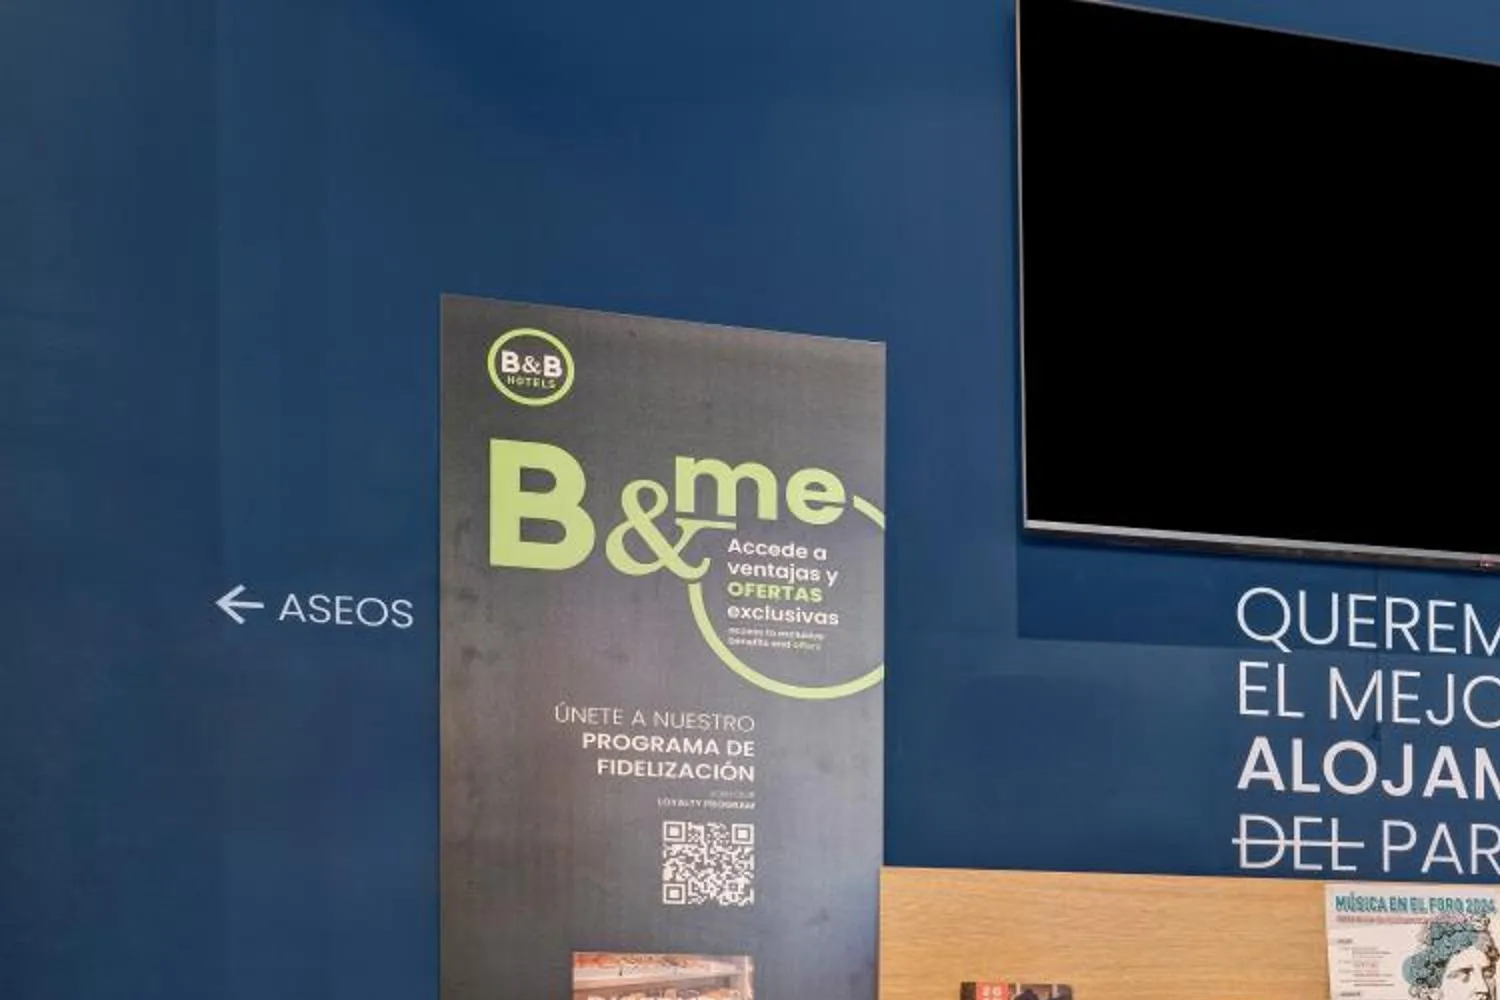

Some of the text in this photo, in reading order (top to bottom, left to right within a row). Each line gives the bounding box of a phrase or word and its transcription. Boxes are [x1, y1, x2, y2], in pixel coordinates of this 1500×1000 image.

[501, 350, 563, 377] B&B
[507, 375, 556, 389] HOTELS
[727, 538, 827, 561] Accede a
[727, 562, 838, 588] ventajas y
[727, 581, 823, 602] OFERTAS
[278, 593, 414, 629] ASEOS
[727, 605, 839, 625] exclusivas
[1238, 660, 1305, 718] EL
[554, 701, 755, 733] ÚNETE A NUESTRO
[582, 732, 755, 757] PROGRAMA DE
[597, 758, 755, 783] FIDELIZACIÓN
[1235, 814, 1360, 871] DEL
[1335, 891, 1387, 913] MÚSICA
[1389, 895, 1407, 913] EN
[1410, 896, 1428, 914] EL
